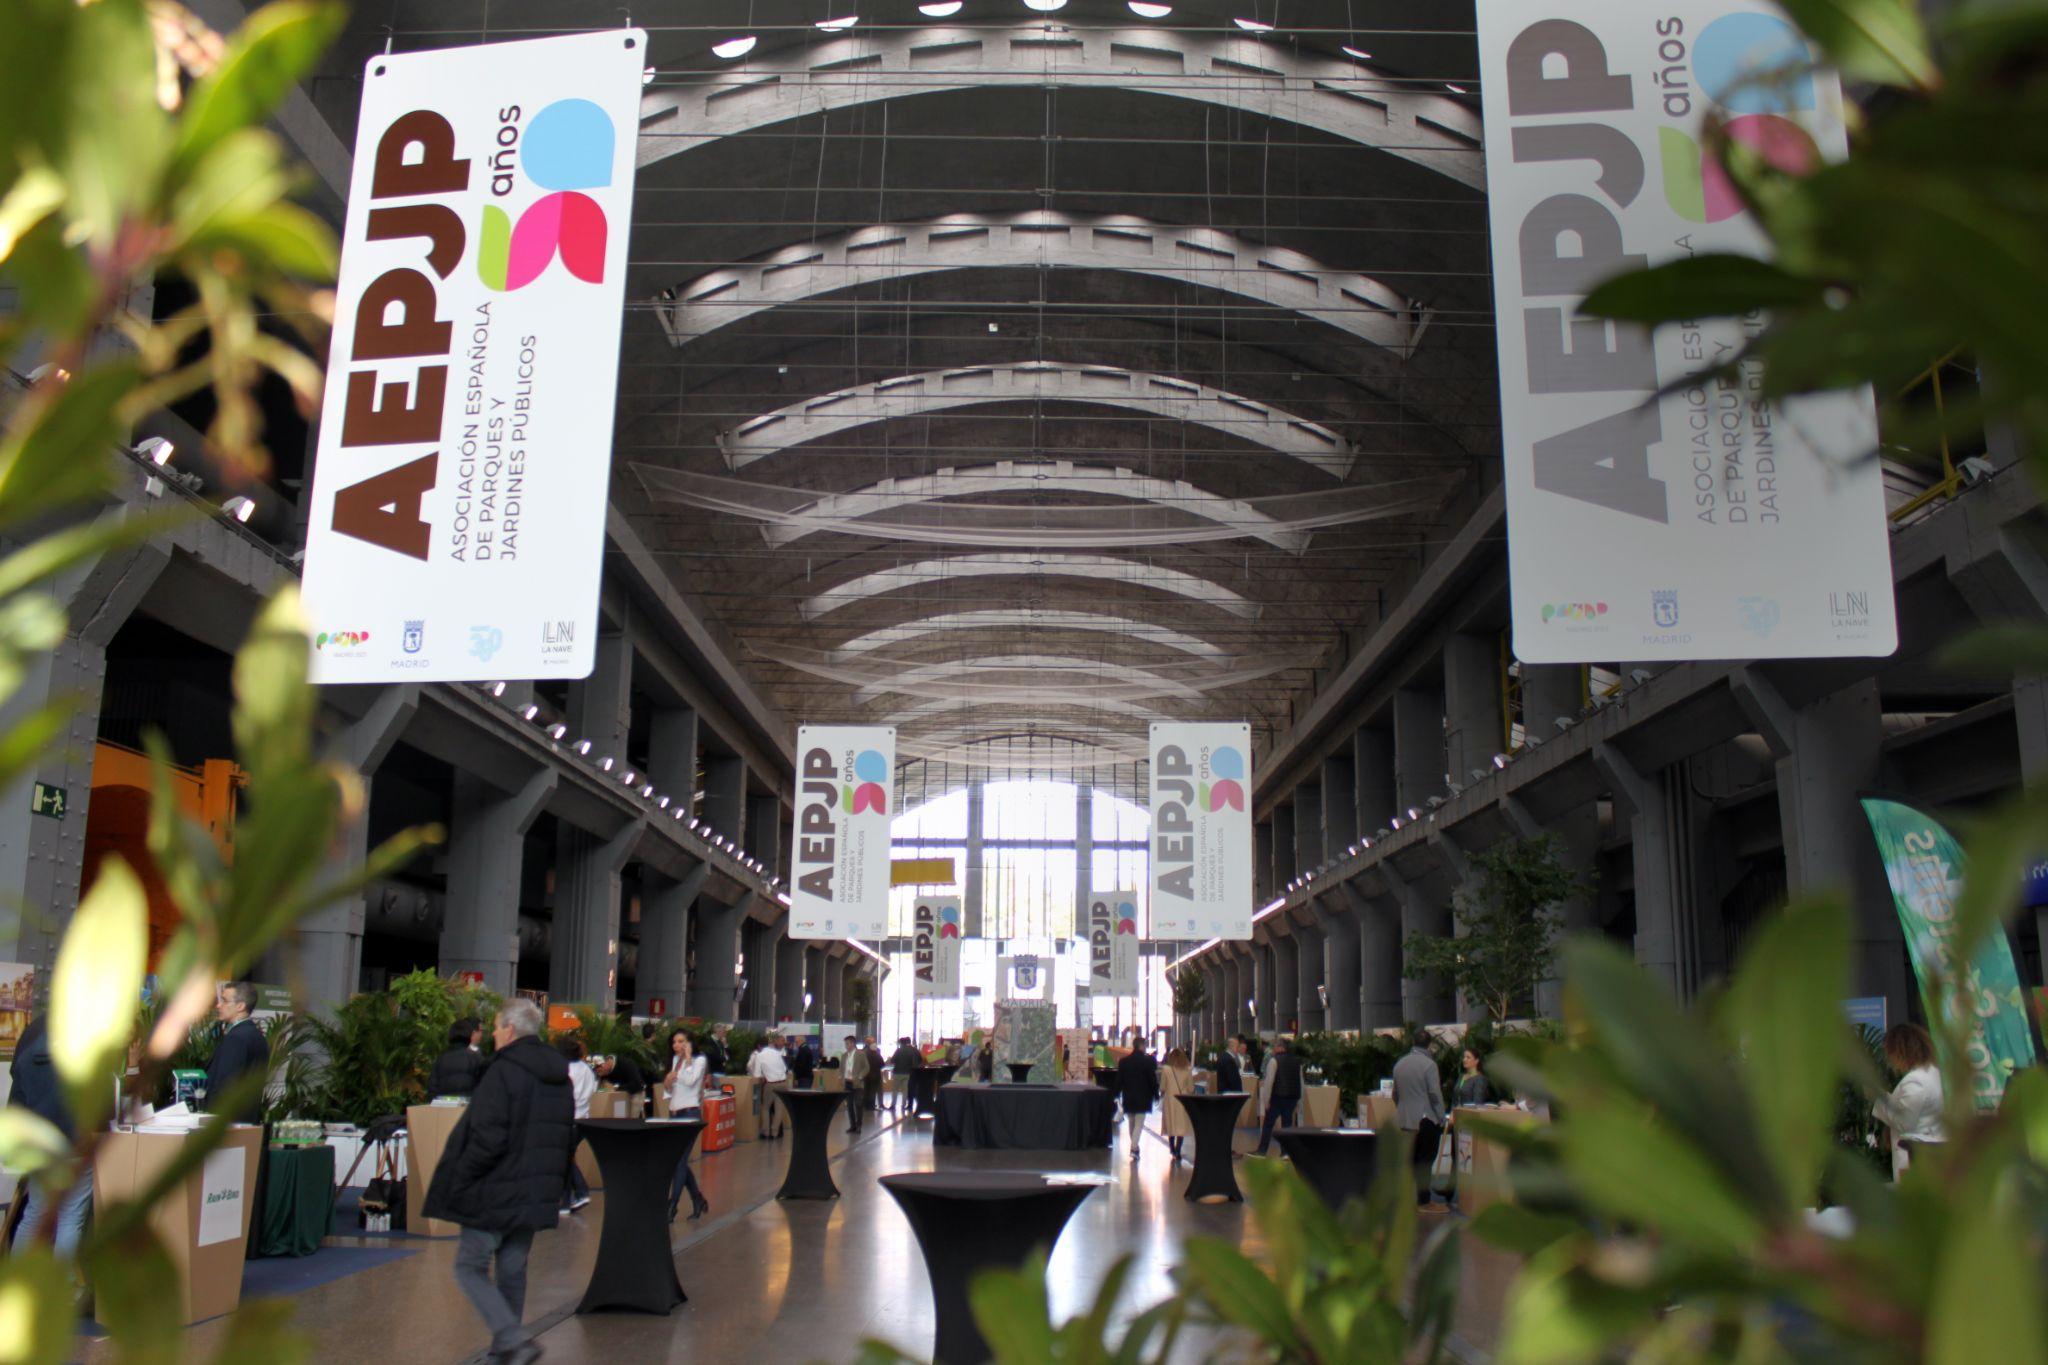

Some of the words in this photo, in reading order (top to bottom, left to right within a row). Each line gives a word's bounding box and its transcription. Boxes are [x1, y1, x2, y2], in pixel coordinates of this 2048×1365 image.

[1653, 16, 1691, 118] años
[488, 105, 521, 197] años
[1506, 18, 1669, 525] AEPJP
[331, 109, 471, 562] AEPJP
[1713, 341, 1733, 355] Y
[489, 397, 505, 410] Y
[509, 335, 536, 441] PÚBLICOS
[1716, 374, 1744, 480] PARQUE
[451, 424, 479, 562] ASOCIACIÓN
[466, 301, 492, 415] ESPAÑOLA
[479, 417, 504, 522] PARQUES
[475, 531, 493, 560] DE
[500, 449, 526, 561] JARDINES
[1727, 490, 1748, 523] DE
[390, 659, 430, 669] MADRID
[1643, 633, 1693, 645] MADRID
[843, 750, 854, 783] años
[1199, 745, 1209, 780] años
[798, 747, 839, 902] AEPJP
[1157, 744, 1195, 901] AEPJP
[916, 905, 934, 983] AEPJP
[1092, 901, 1111, 979] AEPJP
[1001, 998, 1049, 1007] MADRID
